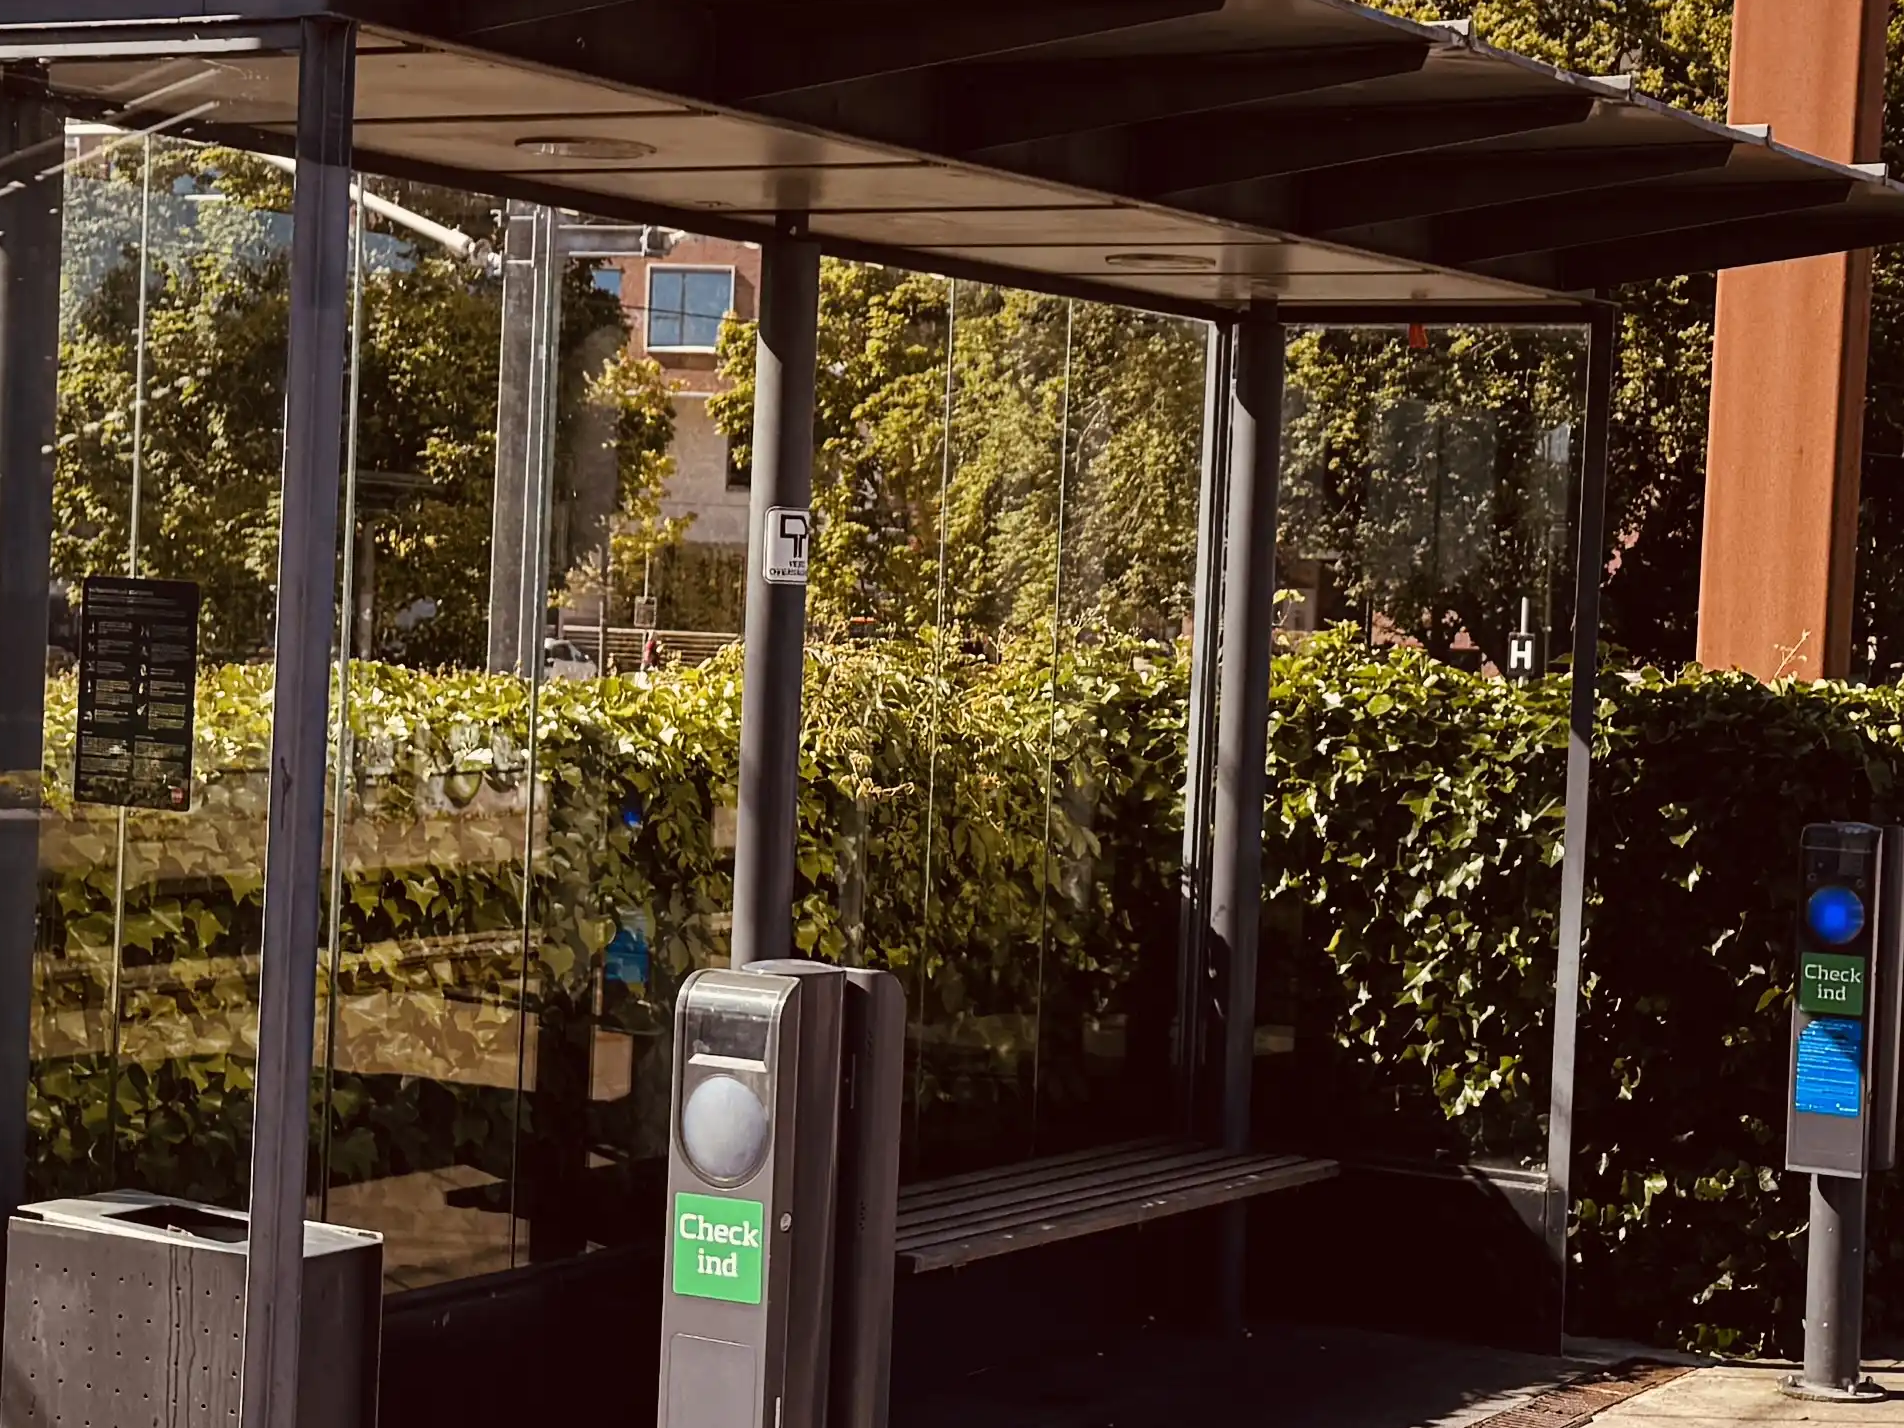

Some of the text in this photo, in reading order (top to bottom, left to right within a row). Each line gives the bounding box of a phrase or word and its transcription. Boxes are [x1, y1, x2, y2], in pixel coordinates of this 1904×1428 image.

[1510, 639, 1532, 670] H
[1804, 963, 1862, 983] Check
[1817, 983, 1846, 1001] ind
[679, 1212, 760, 1248] Check
[697, 1247, 739, 1278] ind
